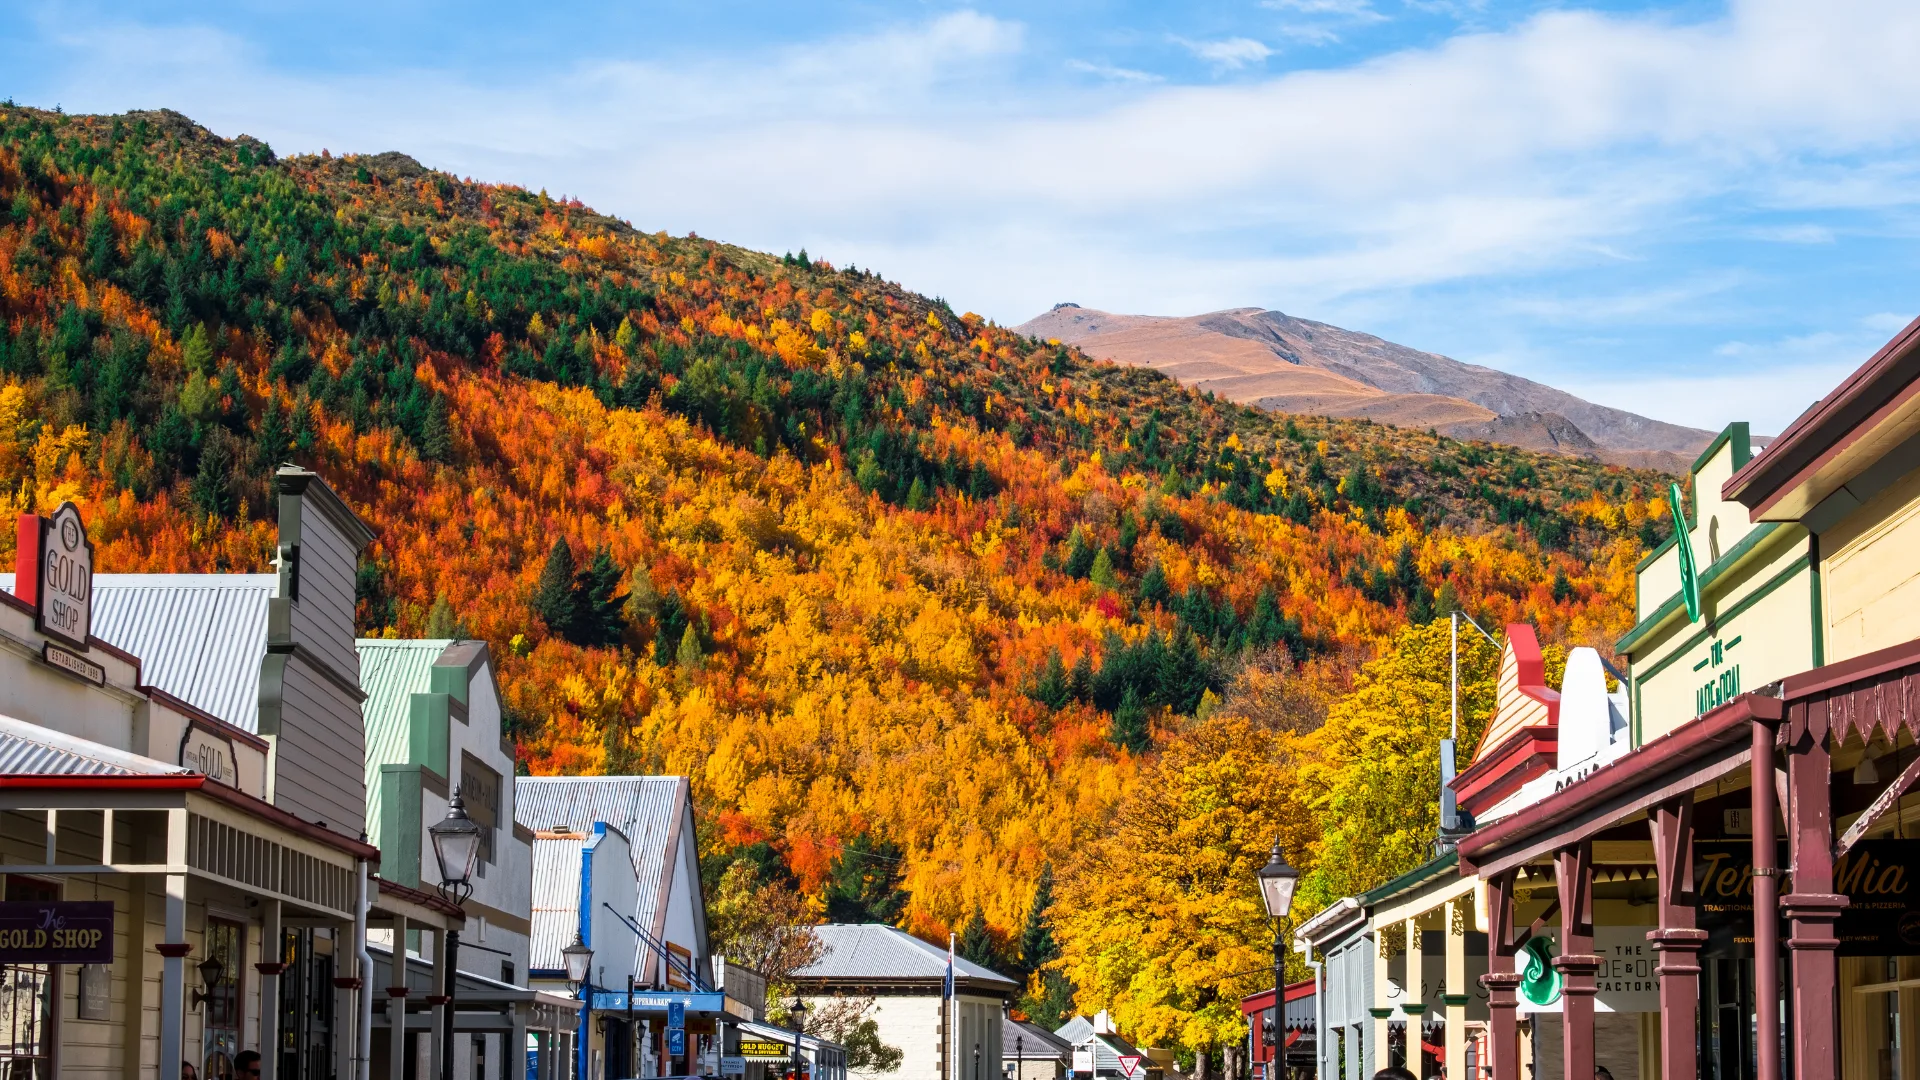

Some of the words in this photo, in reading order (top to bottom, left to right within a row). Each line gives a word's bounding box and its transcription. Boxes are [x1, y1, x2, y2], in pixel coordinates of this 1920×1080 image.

[46, 549, 87, 603] GOLD
[52, 598, 79, 633] SHOP
[51, 649, 87, 674] ESTABLISHED
[1710, 639, 1723, 669] THE
[199, 743, 223, 780] GOLD
[1831, 850, 1909, 895] Mia
[1871, 901, 1907, 909] PIZZERIA
[37, 907, 67, 930] The
[0, 929, 47, 949] GOLD
[52, 929, 103, 949] SHOP
[1615, 946, 1642, 956] THE
[1625, 963, 1633, 973] &
[757, 1043, 785, 1051] NUGGET
